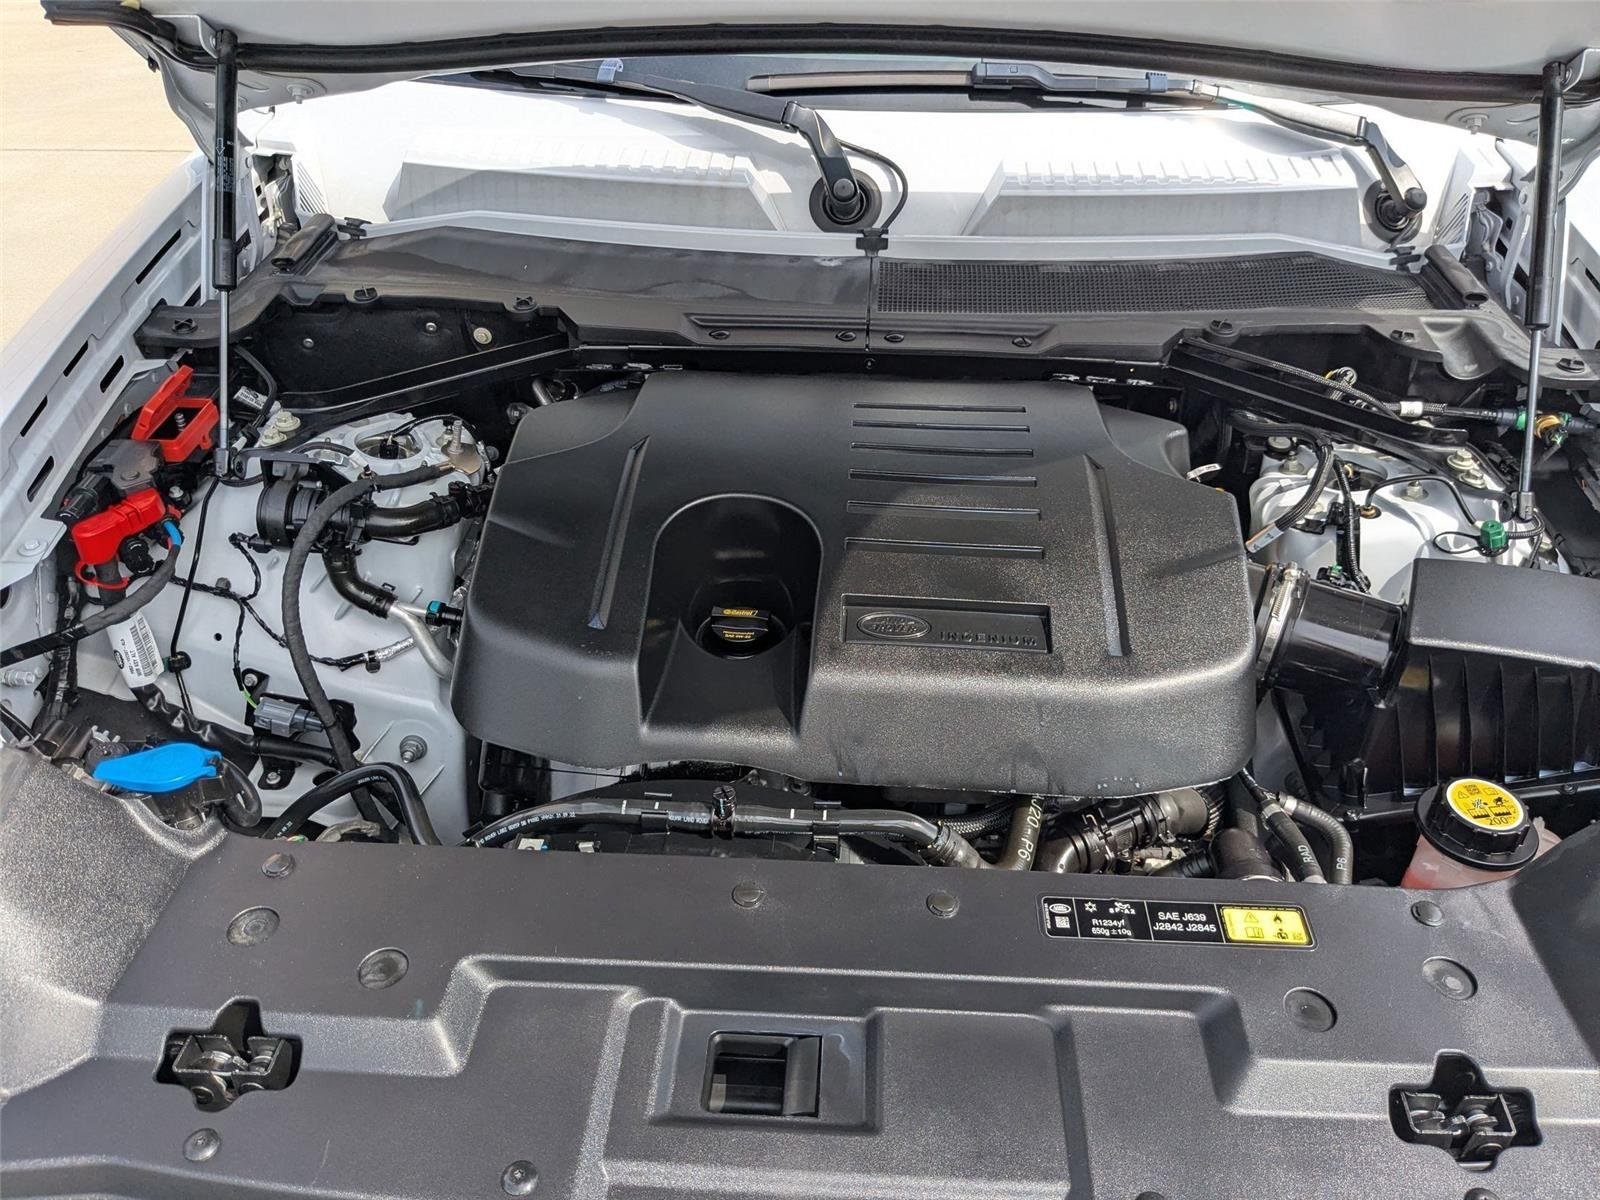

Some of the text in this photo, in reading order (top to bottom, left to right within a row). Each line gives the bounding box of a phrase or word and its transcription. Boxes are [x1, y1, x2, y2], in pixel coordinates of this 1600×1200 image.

[940, 631, 1038, 646] INGENIUM
[1488, 816, 1509, 826] 200
[1297, 844, 1315, 863] RAD
[1336, 857, 1348, 870] P6
[1157, 911, 1207, 922] SAE J639
[1091, 918, 1125, 928] R1234yf
[1153, 922, 1217, 933] J2842 J2845
[1091, 927, 1110, 937] 650g
